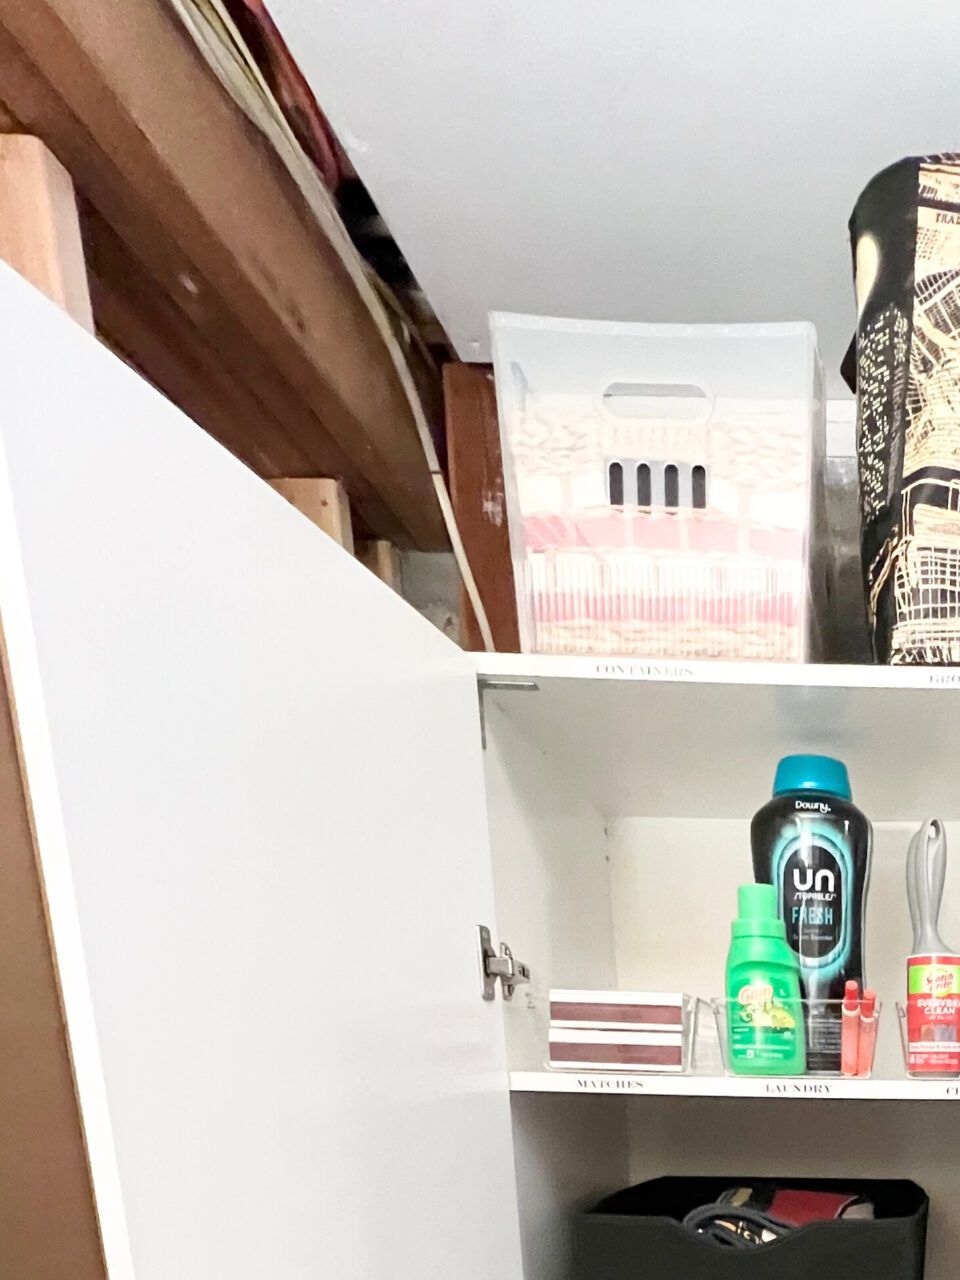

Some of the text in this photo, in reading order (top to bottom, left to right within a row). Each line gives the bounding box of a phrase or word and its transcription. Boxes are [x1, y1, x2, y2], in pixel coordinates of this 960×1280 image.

[596, 664, 693, 676] CONTAINERS
[795, 801, 829, 813] Downy
[577, 1079, 643, 1089] MATCHES
[766, 1084, 832, 1093] LAUNDRY
